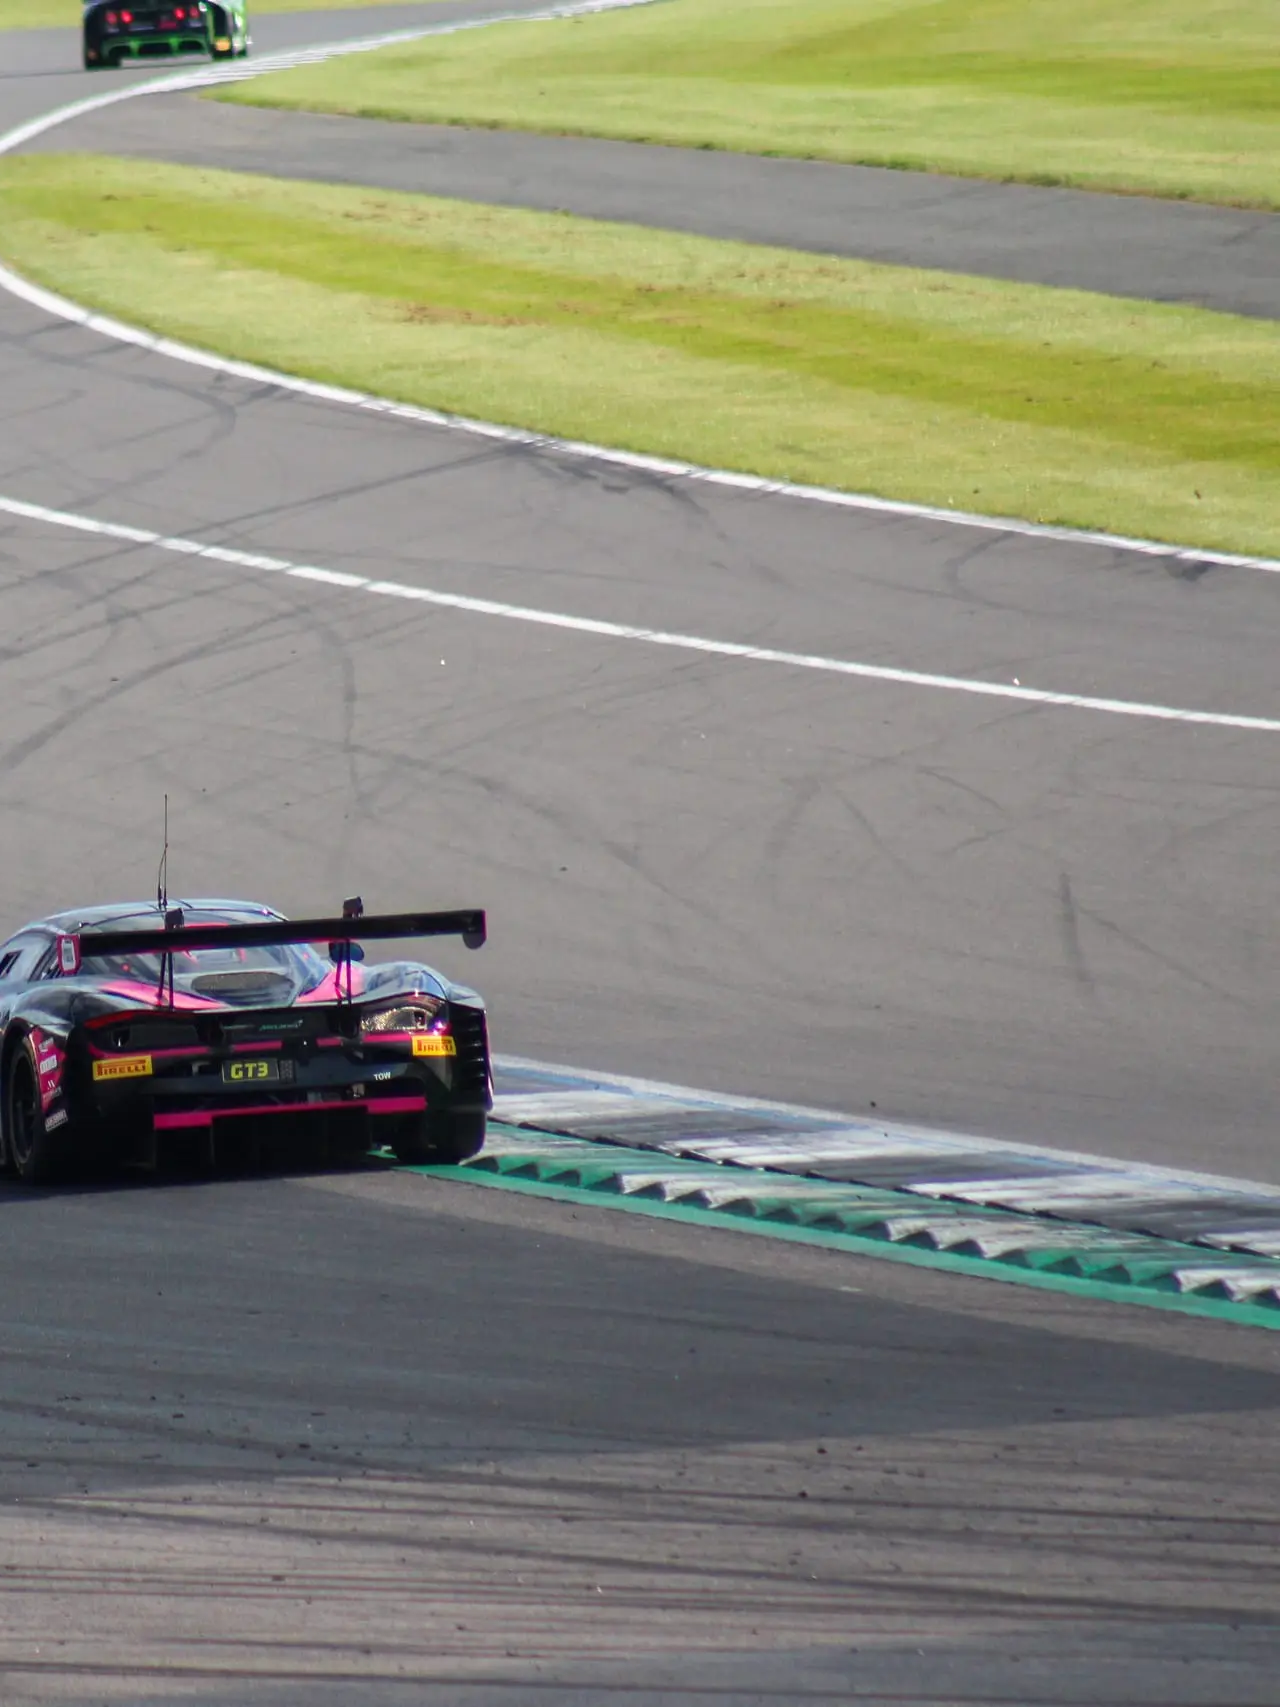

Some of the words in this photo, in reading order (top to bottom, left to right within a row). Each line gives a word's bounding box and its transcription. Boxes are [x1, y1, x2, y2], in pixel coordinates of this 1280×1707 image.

[97, 1059, 147, 1076] PIRELLI
[230, 1062, 269, 1079] GT3
[373, 1071, 391, 1081] TOW
